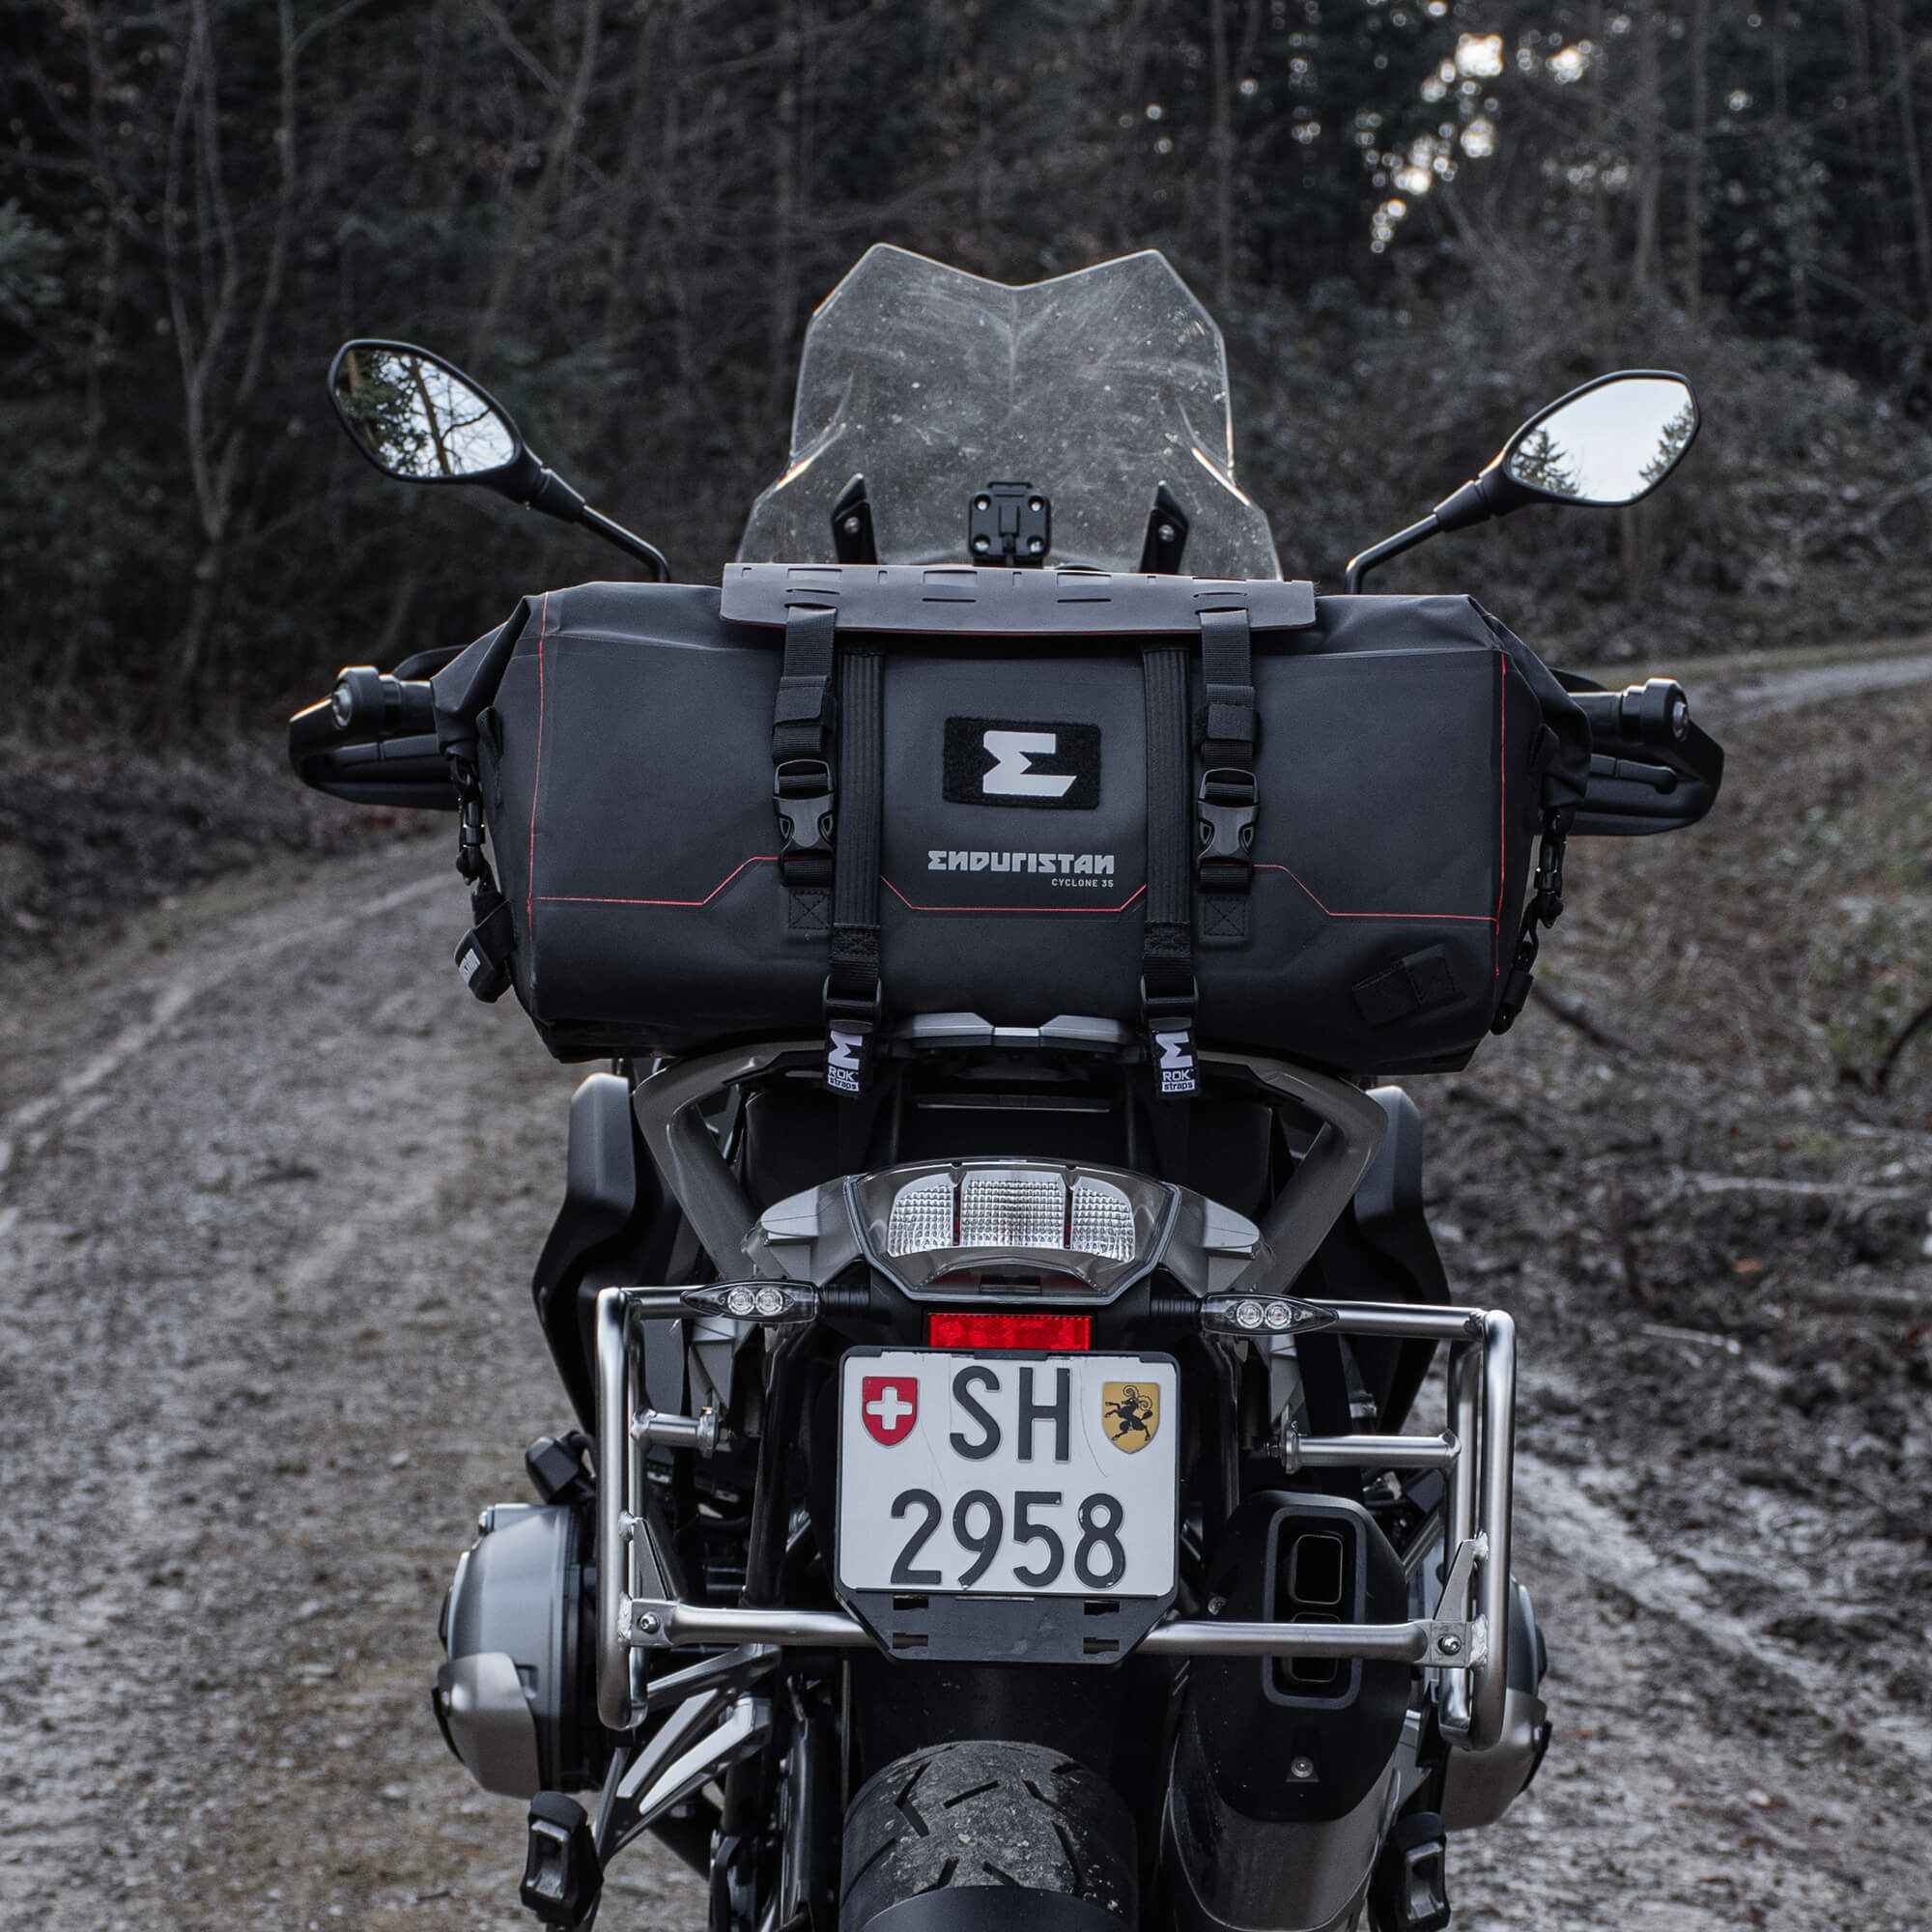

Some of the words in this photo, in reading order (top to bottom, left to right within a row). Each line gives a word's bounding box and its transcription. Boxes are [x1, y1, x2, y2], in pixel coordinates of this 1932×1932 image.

[927, 850, 1115, 874] ENDURISTAN
[1051, 878, 1098, 888] CYCLONE
[829, 1065, 856, 1081] ROK
[1162, 1069, 1190, 1081] ROK
[950, 1366, 1070, 1461] SH
[890, 1489, 1126, 1589] 2958
